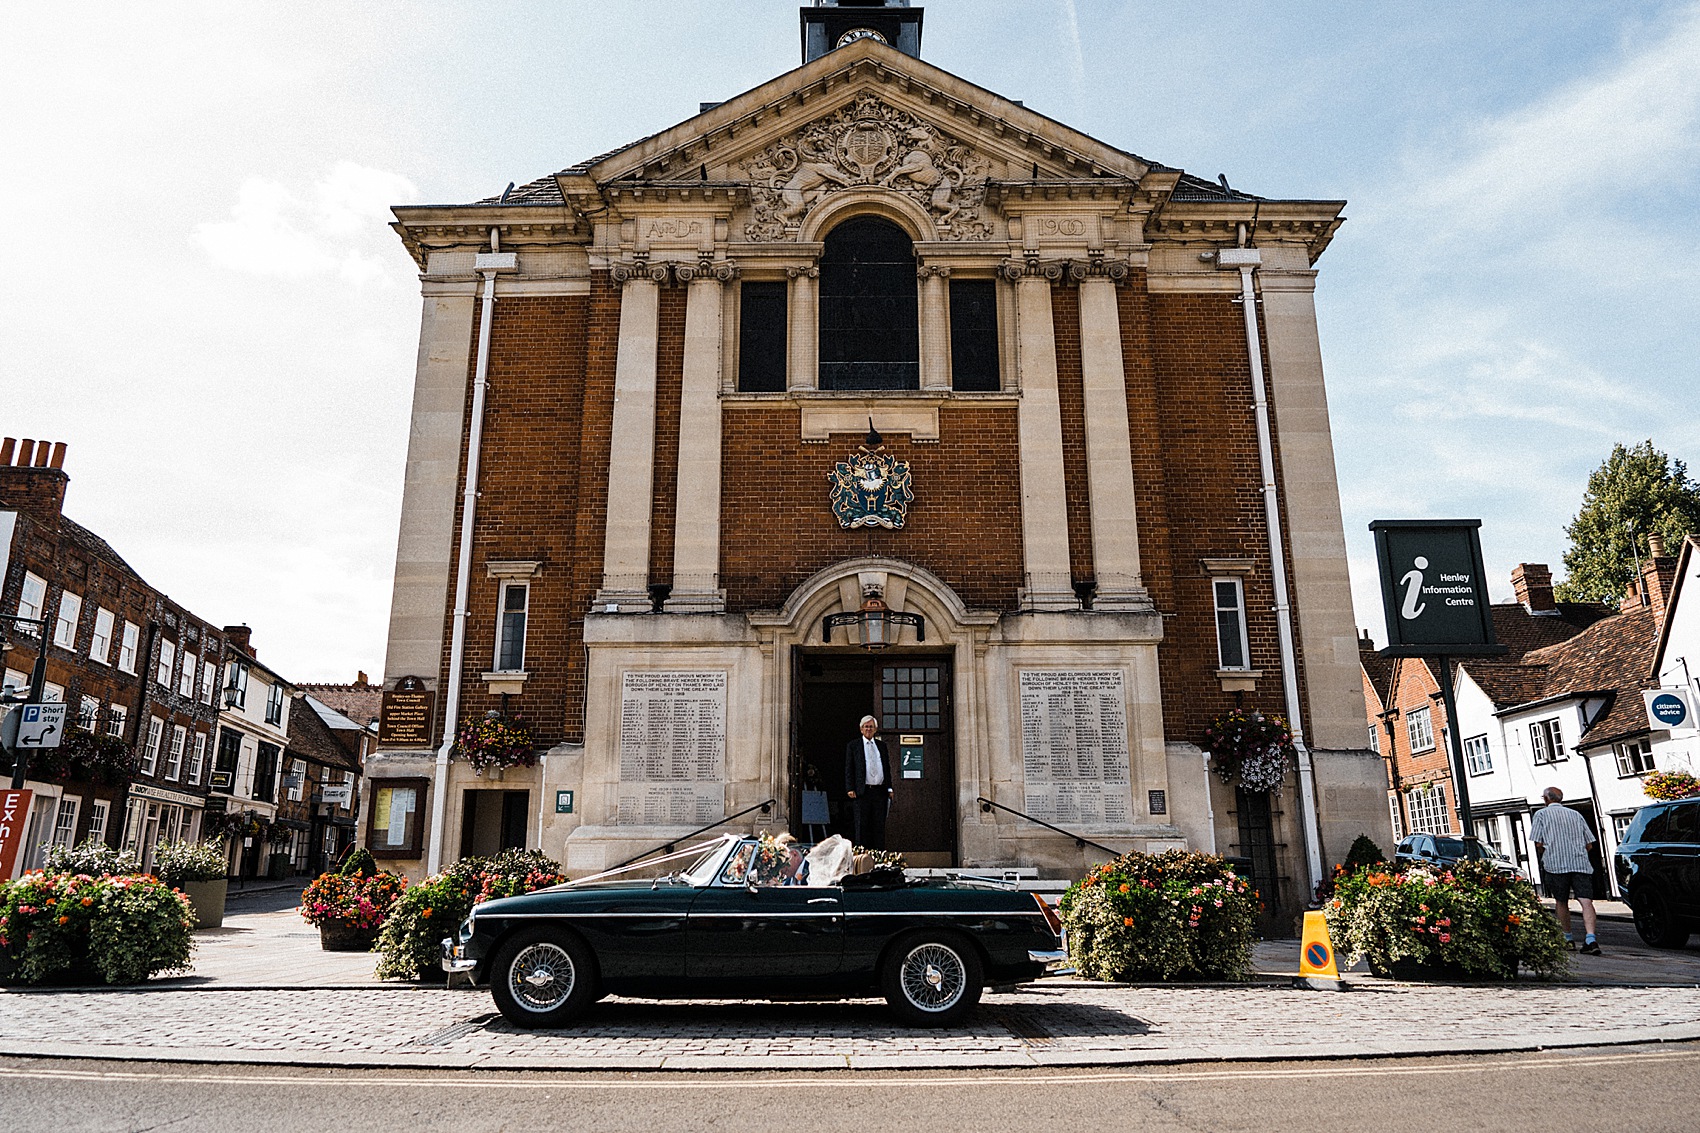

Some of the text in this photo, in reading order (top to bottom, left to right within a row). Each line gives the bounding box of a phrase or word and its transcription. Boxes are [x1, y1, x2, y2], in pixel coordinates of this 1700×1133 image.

[1440, 573, 1469, 583] Henley
[1422, 585, 1472, 594] Information
[1445, 597, 1474, 606] Centre
[27, 708, 38, 721] P
[41, 706, 64, 714] Short
[42, 715, 60, 723] stay
[156, 789, 178, 800] HEALTH
